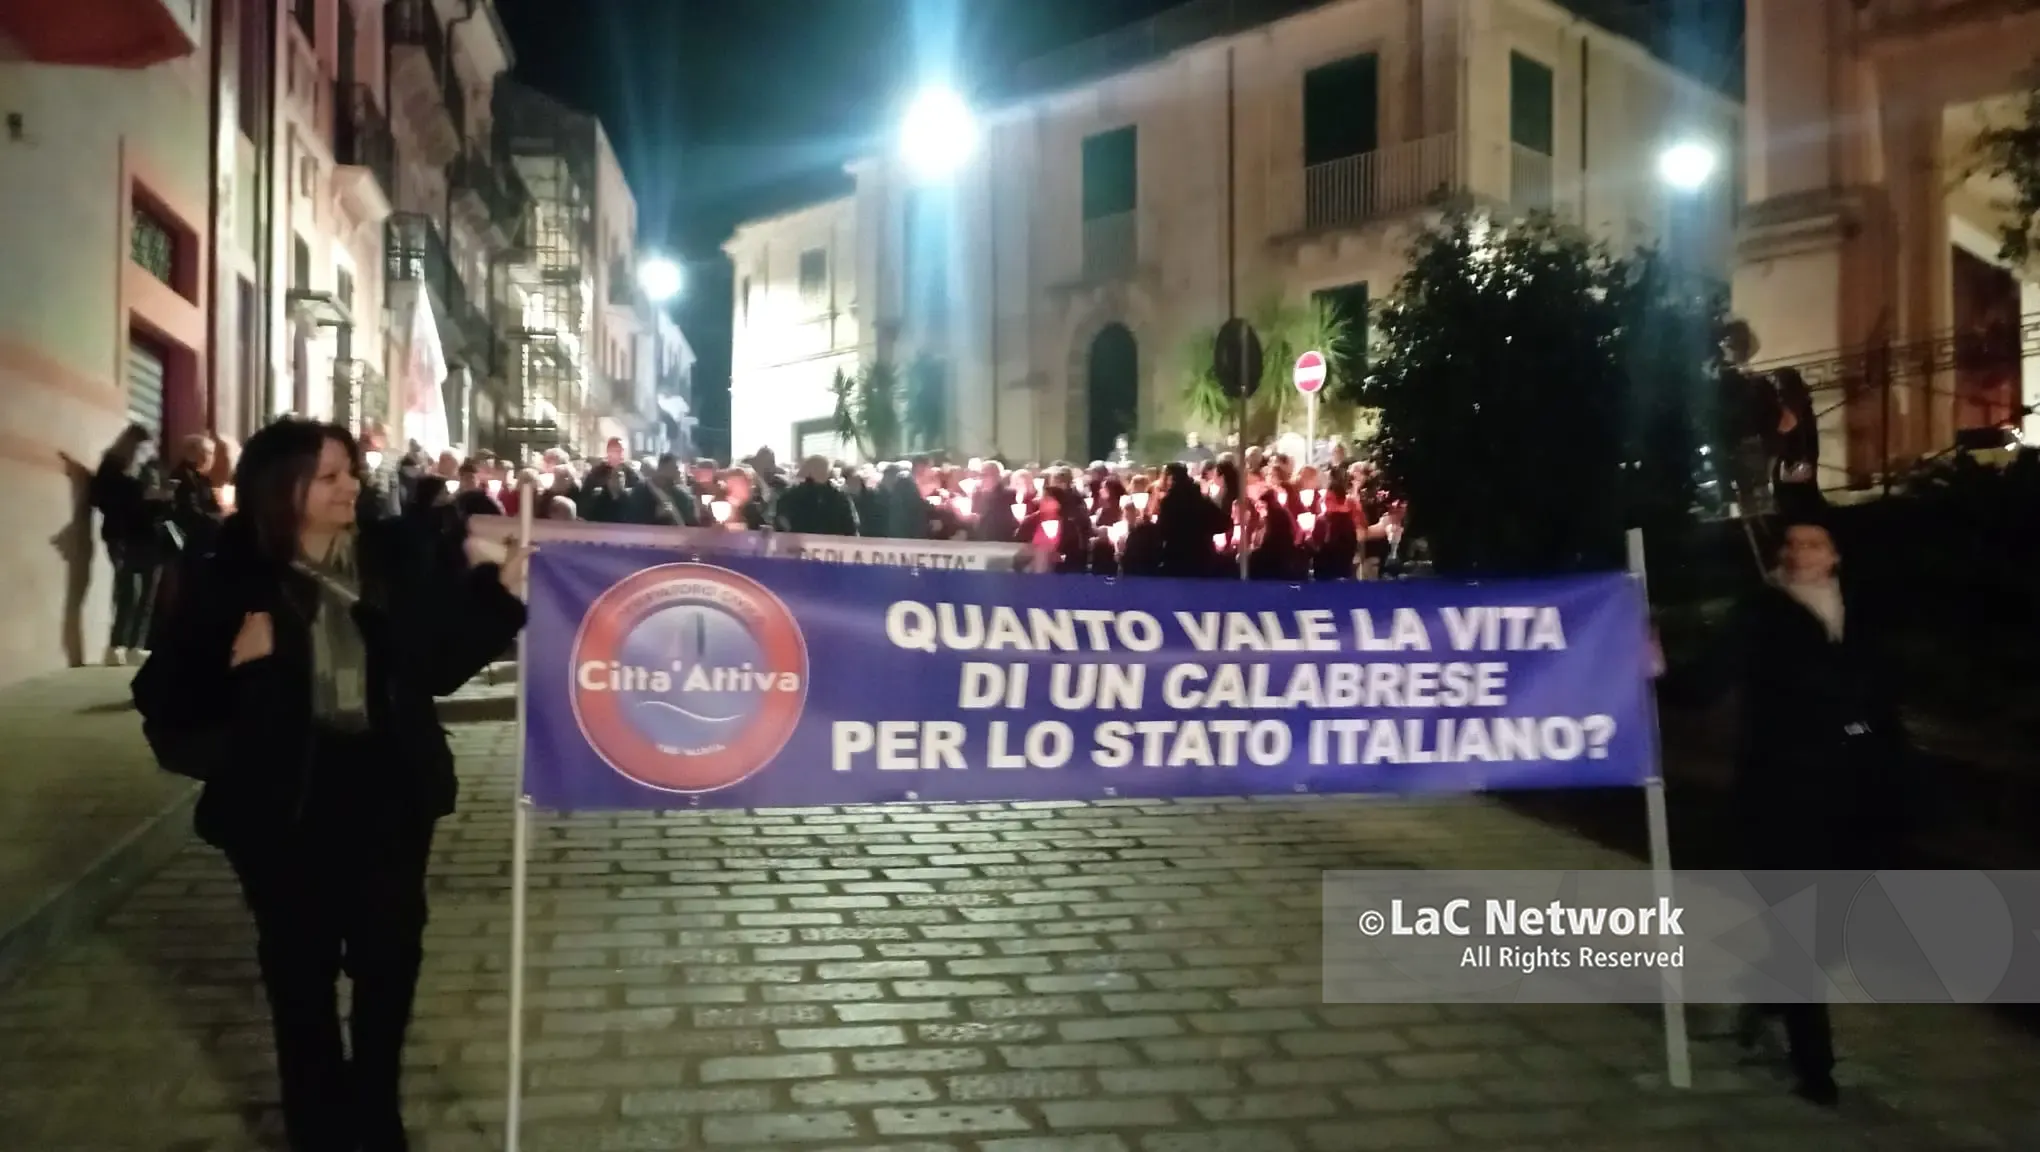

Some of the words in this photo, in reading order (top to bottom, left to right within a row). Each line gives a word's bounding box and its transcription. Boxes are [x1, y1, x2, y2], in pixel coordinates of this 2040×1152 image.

[886, 600, 1164, 653] QUANTO
[1173, 609, 1341, 652] VALE
[1350, 607, 1432, 652] LA
[1438, 606, 1567, 652] VITA
[958, 661, 1029, 710] DI
[1049, 662, 1146, 710] UN
[1162, 661, 1509, 709] CALABRESE
[831, 720, 968, 771] PER
[987, 720, 1074, 769] LO
[1090, 719, 1293, 768] STATO
[1308, 714, 1617, 765] ITALIANO?
